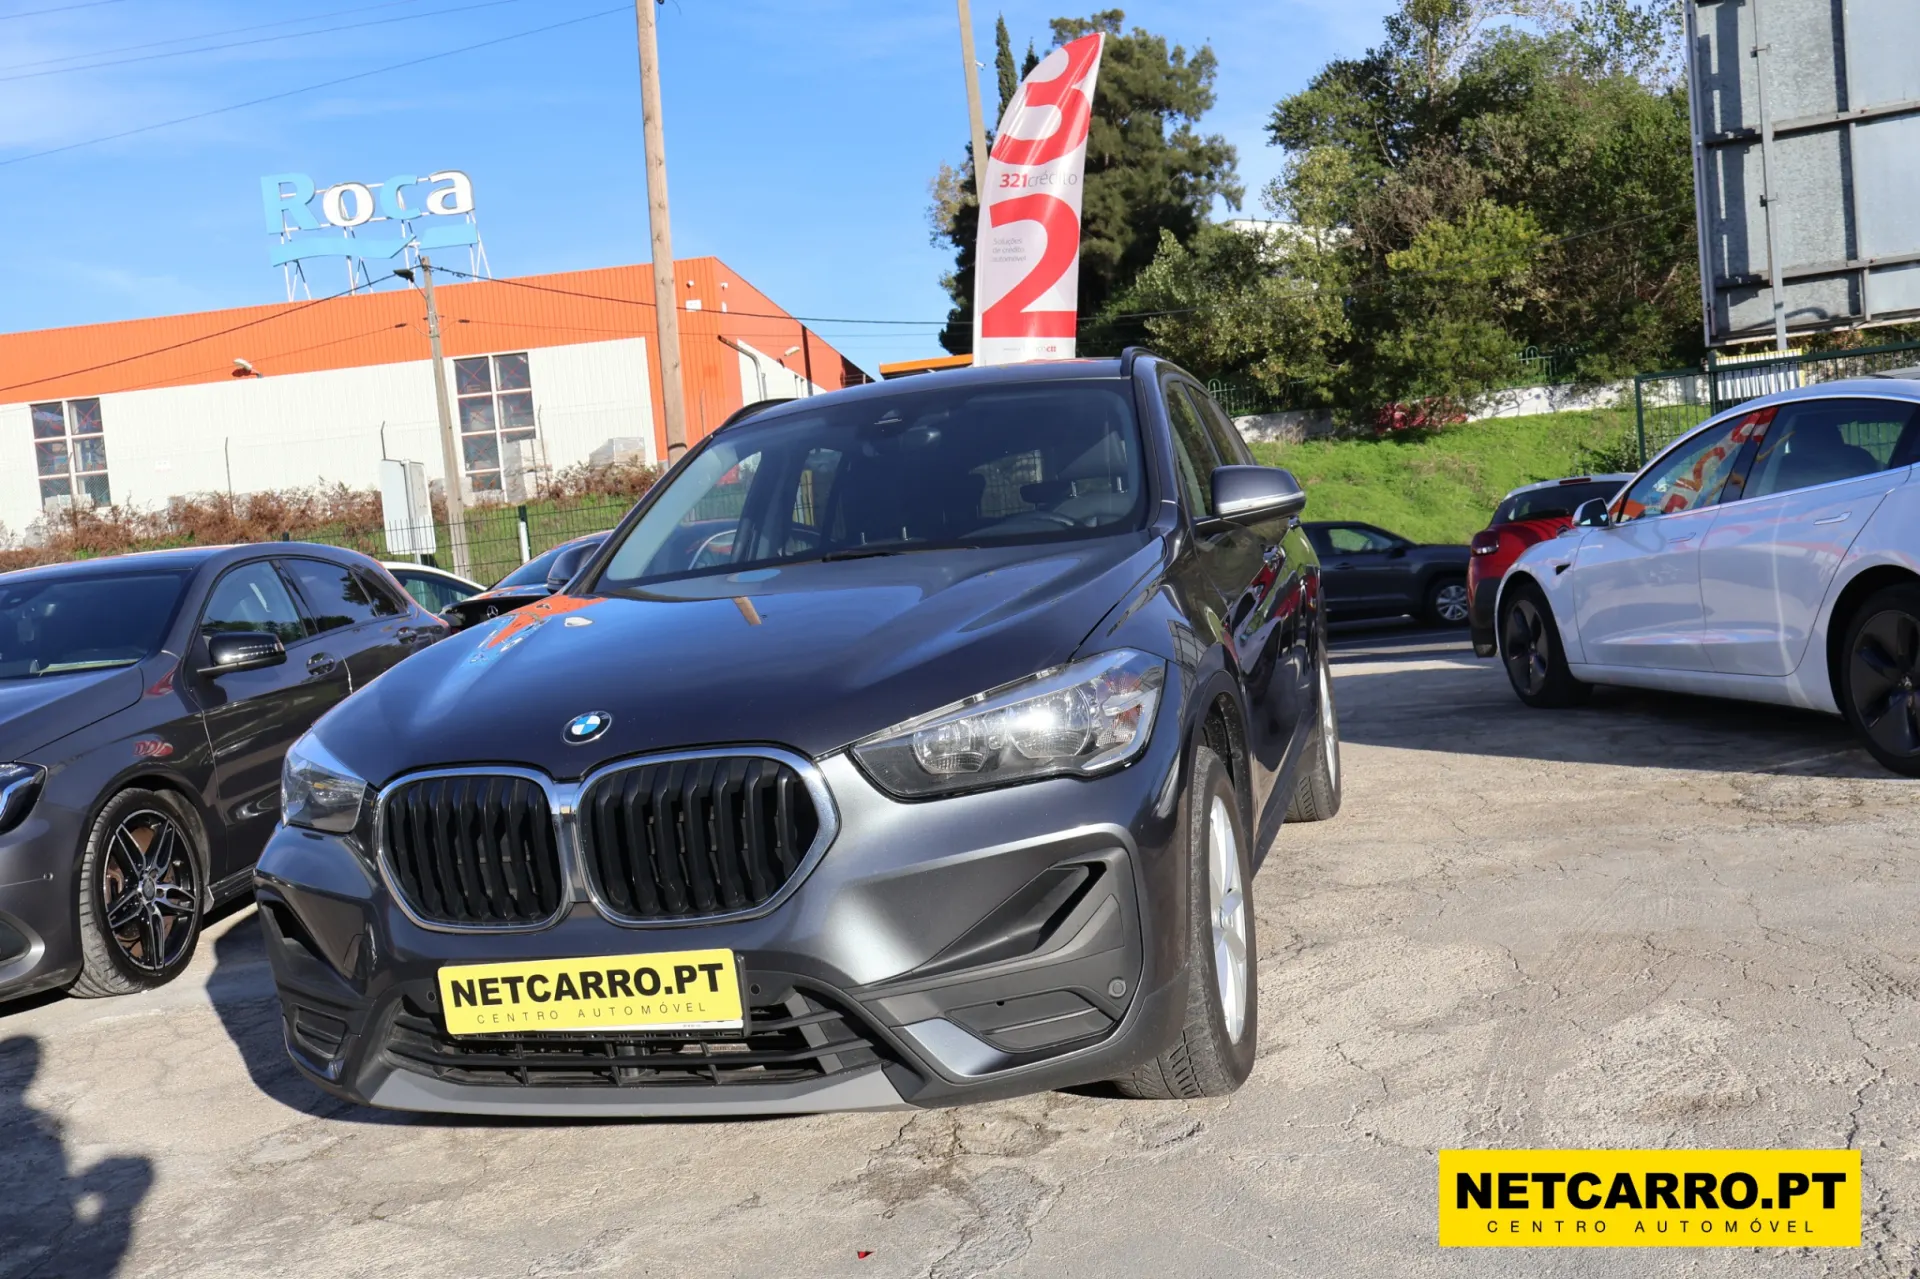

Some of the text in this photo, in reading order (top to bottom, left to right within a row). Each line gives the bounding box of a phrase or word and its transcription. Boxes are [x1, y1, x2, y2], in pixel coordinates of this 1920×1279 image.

[260, 169, 475, 235] Roca
[999, 171, 1078, 188] 321créto
[981, 192, 1080, 338] 2
[450, 962, 724, 1008] NETCARRO.PT
[477, 1001, 706, 1024] CENTRO AUTOMÓVEL
